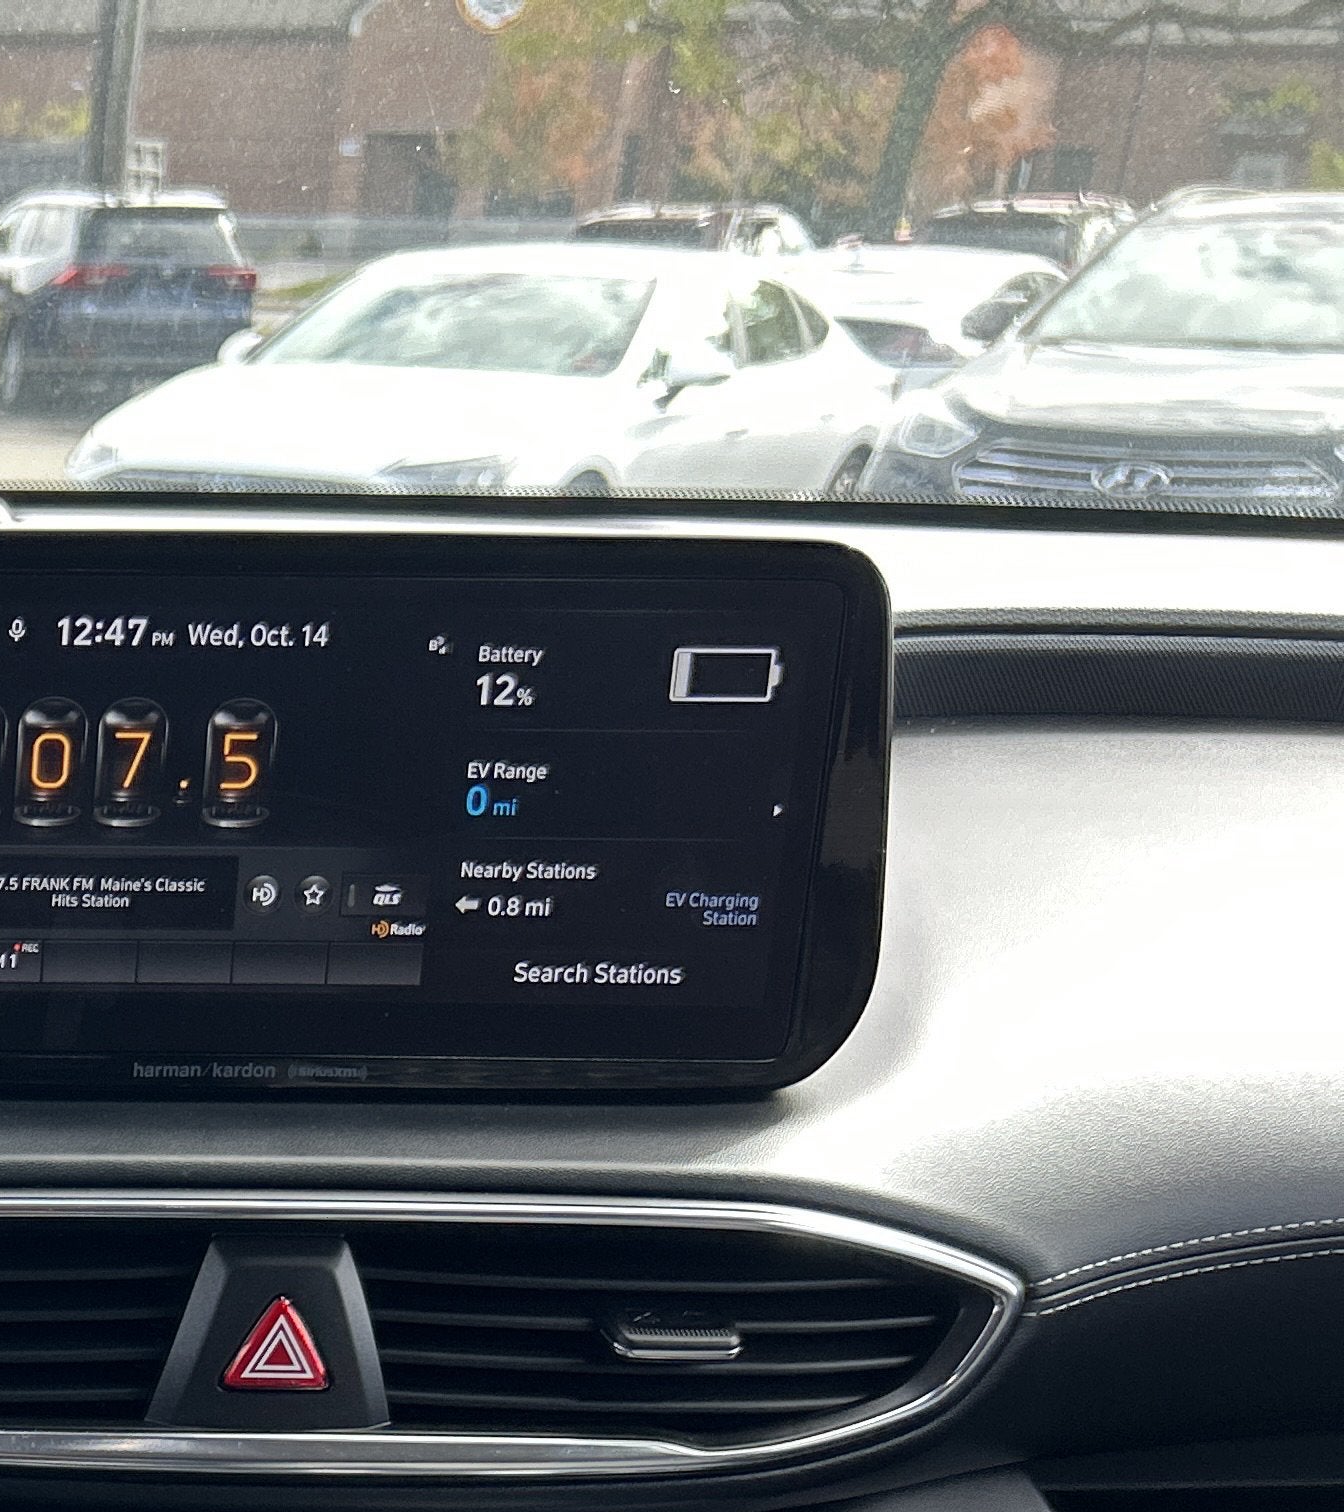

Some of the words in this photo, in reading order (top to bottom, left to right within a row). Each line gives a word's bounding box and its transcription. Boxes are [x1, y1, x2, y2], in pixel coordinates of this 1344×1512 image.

[56, 617, 148, 647] 12:47
[151, 632, 174, 646] PM
[187, 623, 244, 649] Wed,
[250, 623, 293, 647] Oct.
[301, 624, 329, 647] 14
[478, 646, 543, 666] Battery
[467, 763, 490, 780] EV
[494, 763, 548, 782] Range
[466, 785, 488, 816] 0
[492, 799, 518, 816] mi
[460, 862, 523, 882] Nearby
[526, 862, 597, 881] Stations
[21, 877, 70, 892] FRANK
[72, 877, 94, 892] FM
[99, 877, 152, 893] Maine's
[155, 877, 205, 893] Classic
[51, 894, 75, 908] Hits
[77, 894, 129, 908] Station
[487, 897, 520, 917] 0.8
[524, 897, 553, 917] mi
[665, 893, 686, 908] EV
[688, 893, 759, 912] Charging
[702, 911, 758, 926] Station
[9, 953, 17, 968] 1
[513, 963, 588, 984] Search
[593, 963, 683, 985] Stations
